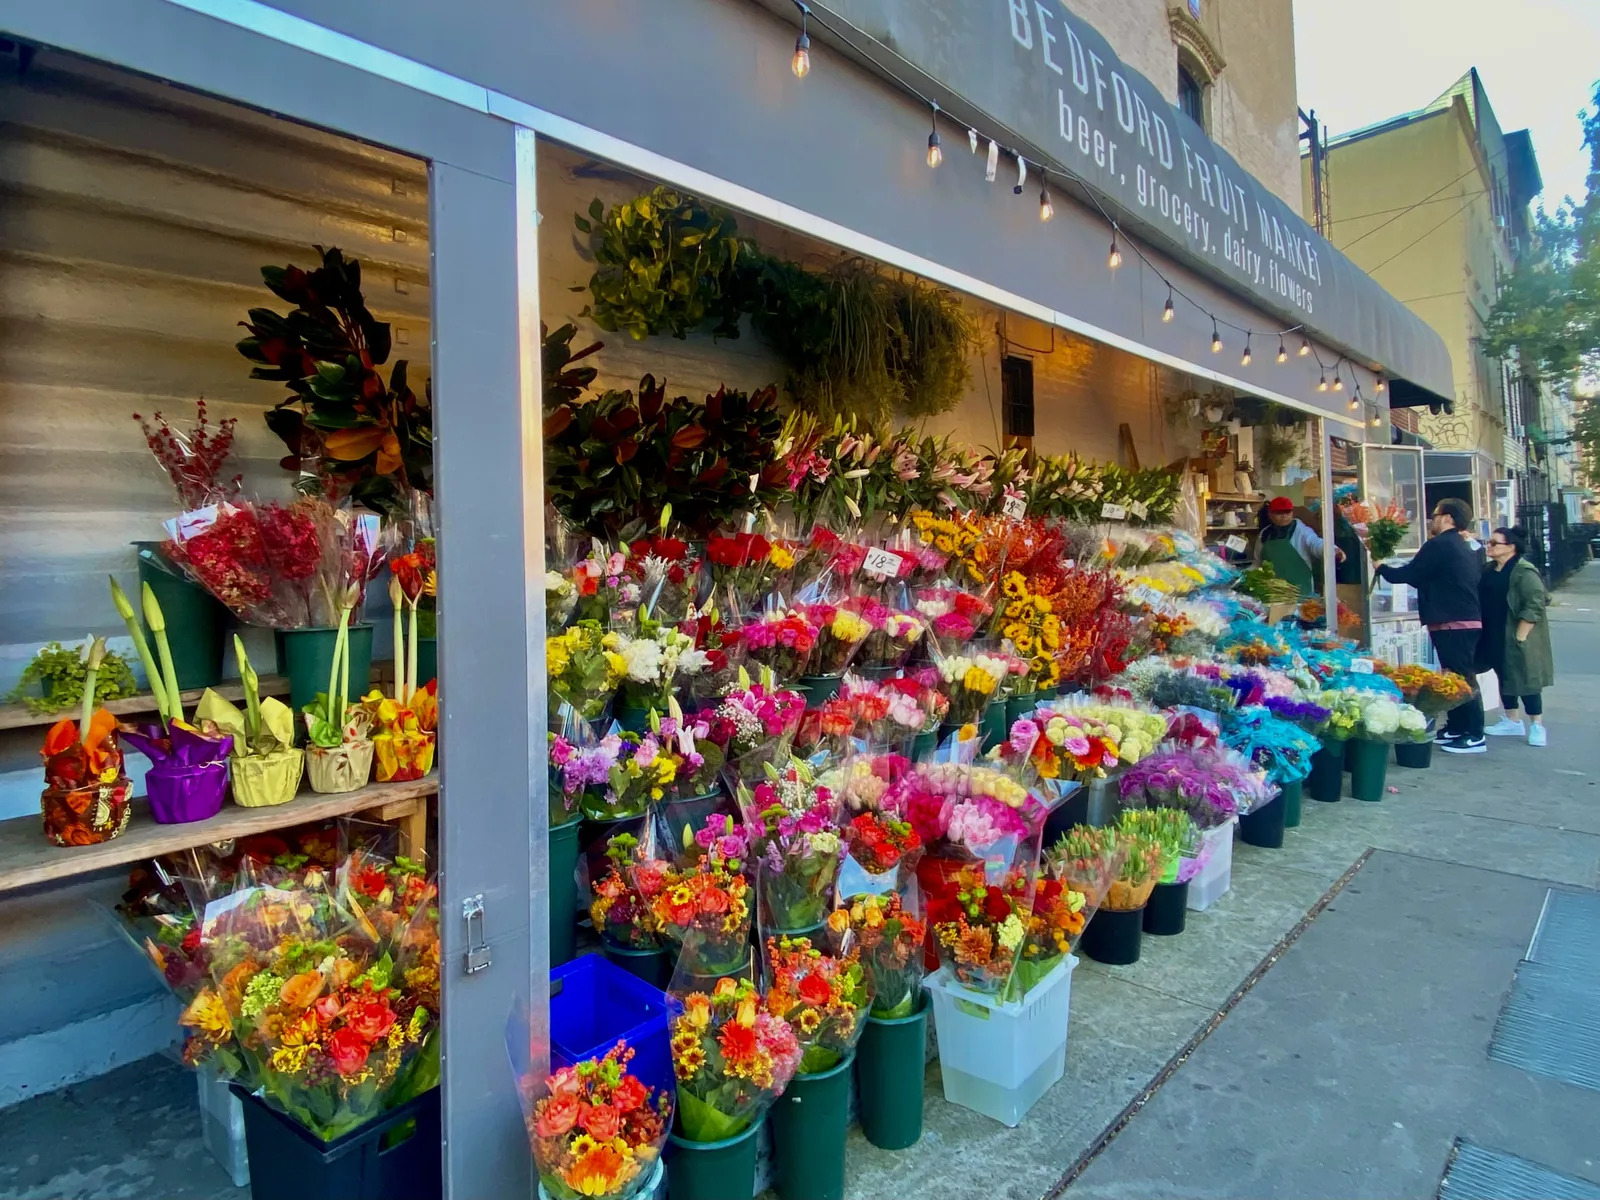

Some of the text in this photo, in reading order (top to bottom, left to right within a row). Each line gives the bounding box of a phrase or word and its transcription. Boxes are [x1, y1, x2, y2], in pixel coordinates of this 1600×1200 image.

[1008, 0, 1321, 287] BEDFORD FRUIT MARKET
[1058, 88, 1313, 314] beer, grocery, dairy, flowers
